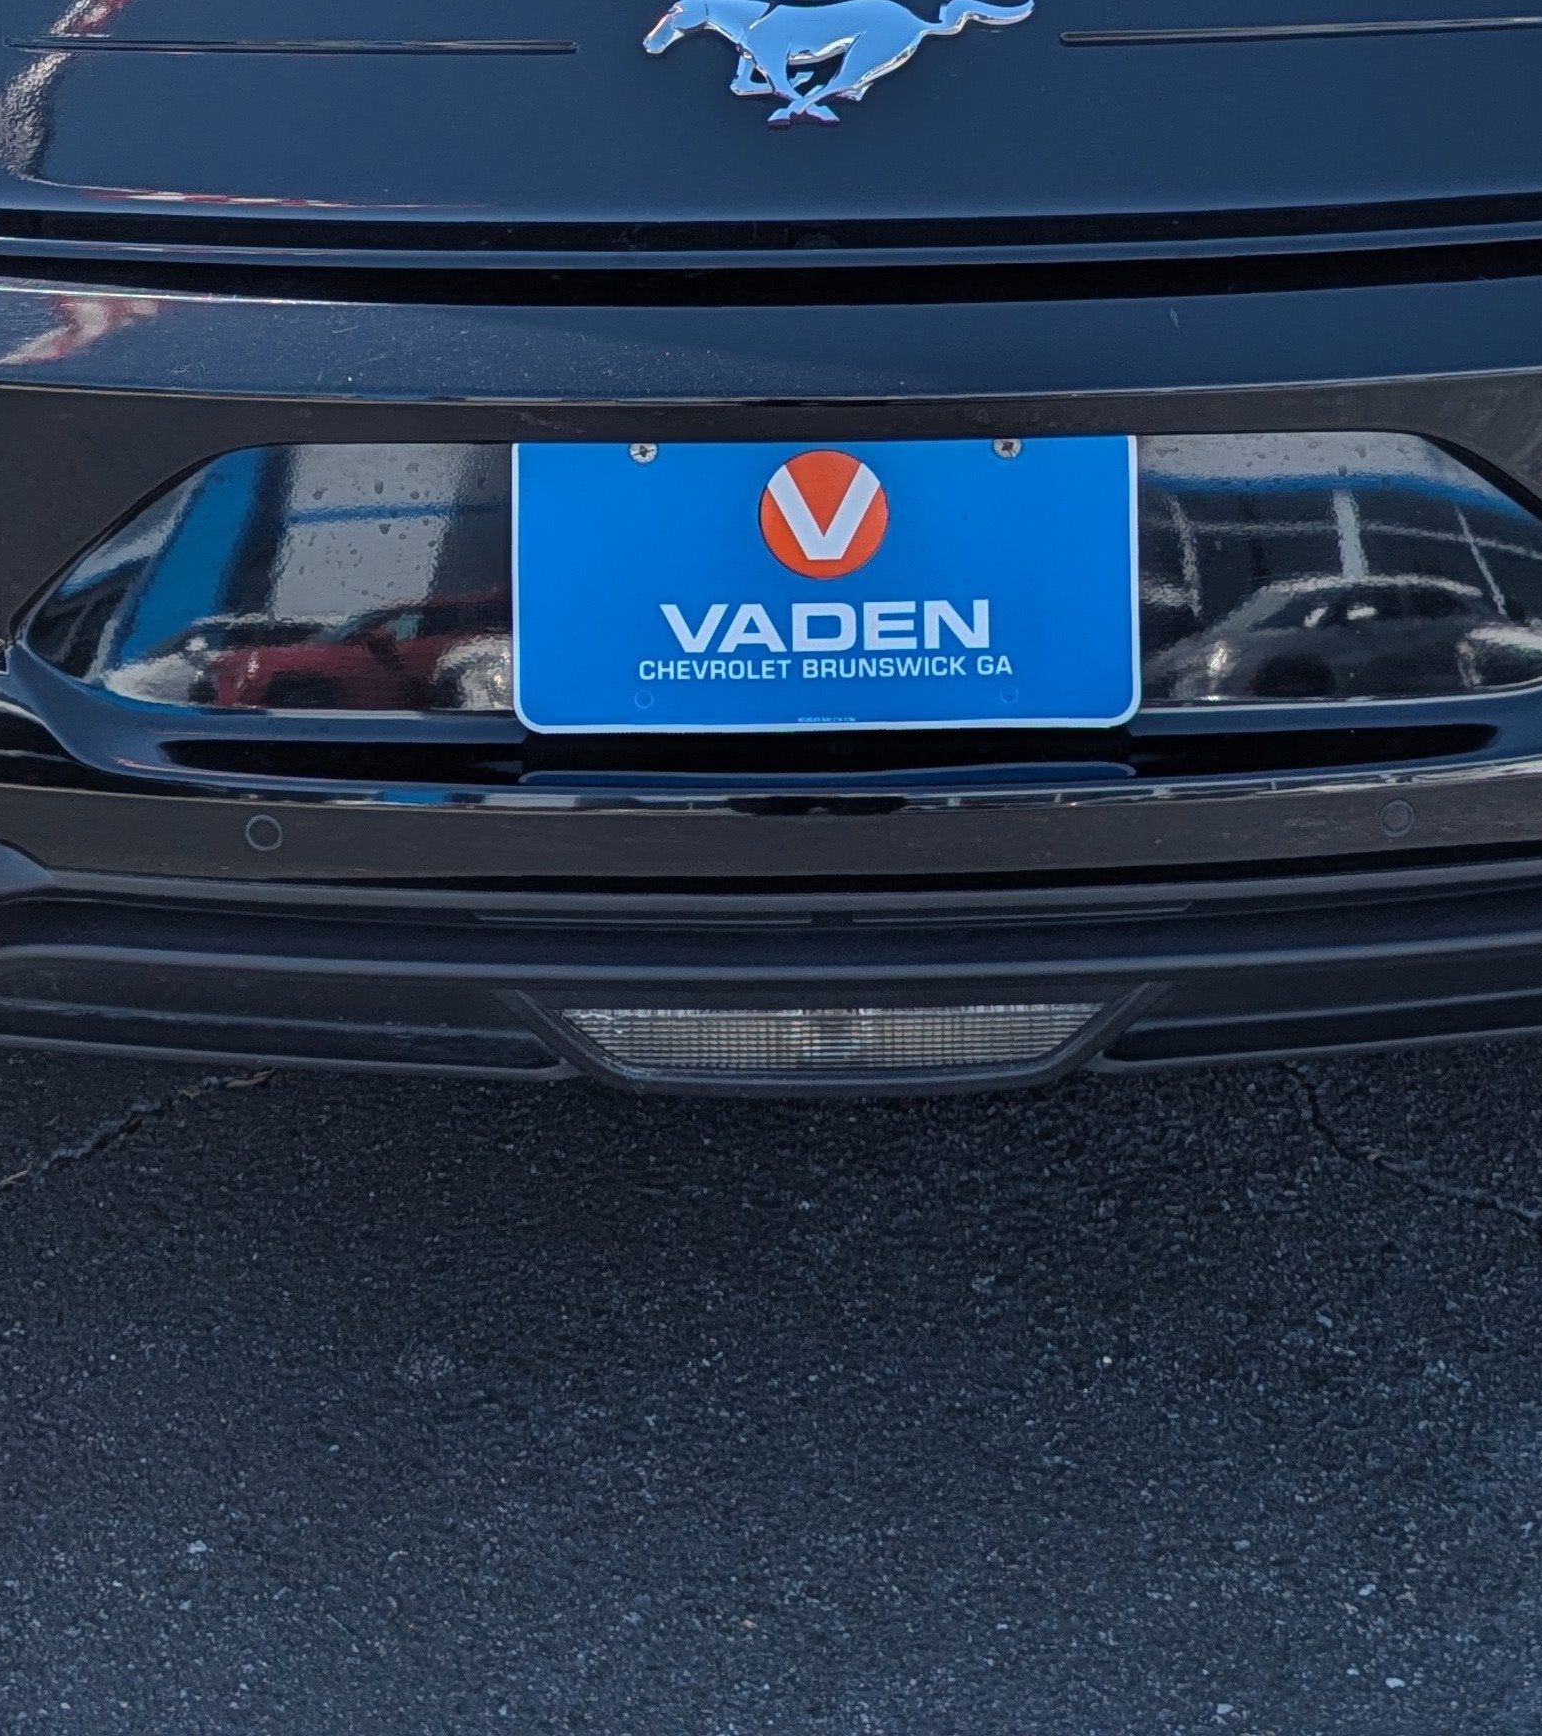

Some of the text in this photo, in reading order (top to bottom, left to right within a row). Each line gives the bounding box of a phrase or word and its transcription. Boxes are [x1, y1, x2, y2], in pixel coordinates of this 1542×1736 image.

[767, 464, 881, 561] V
[659, 598, 990, 653] VADEN
[638, 655, 1013, 681] CHEVROLET BRUNSWICK GA
